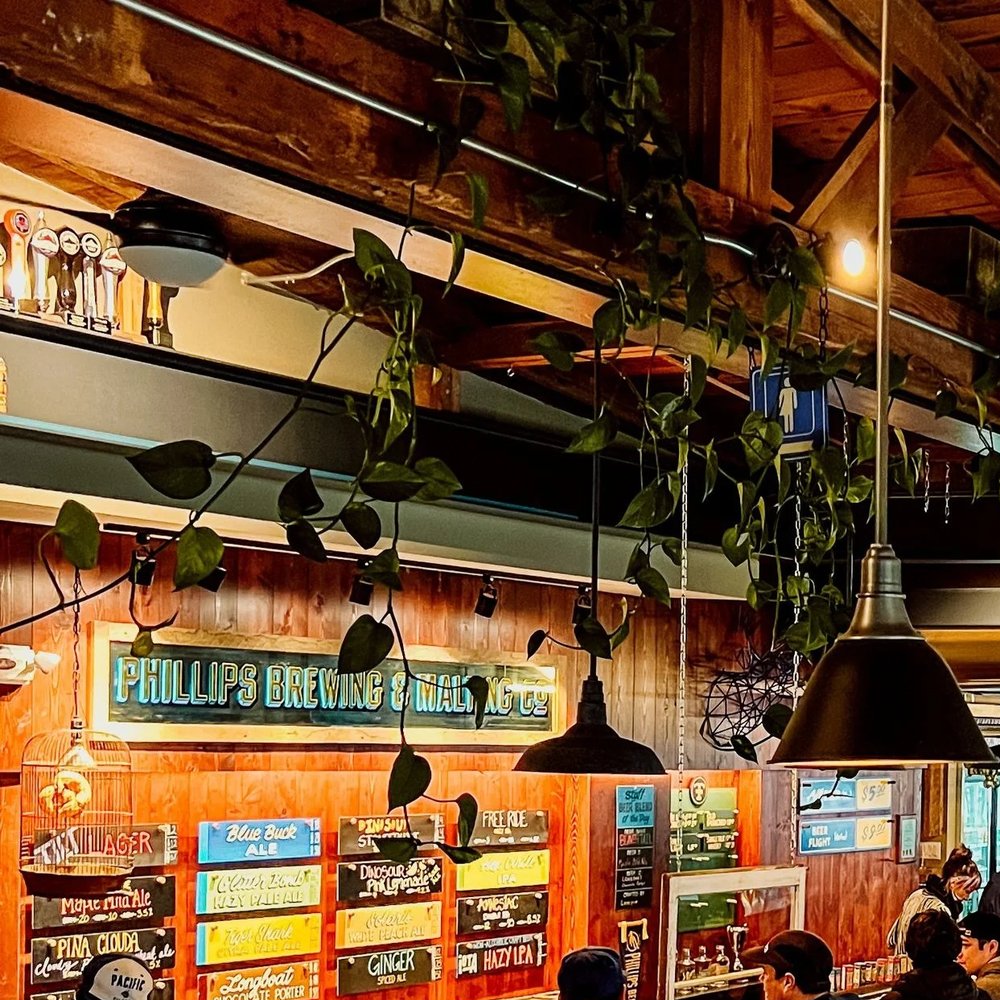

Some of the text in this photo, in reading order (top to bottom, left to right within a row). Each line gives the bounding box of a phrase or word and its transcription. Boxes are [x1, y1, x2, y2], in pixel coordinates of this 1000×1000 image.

[115, 656, 258, 707] PHILLIPS
[265, 663, 385, 712] BREWING
[390, 671, 411, 712] &
[415, 672, 513, 716] MALTNG
[482, 810, 507, 828] FREE
[225, 824, 261, 842] Blue
[262, 822, 298, 841] Buck
[811, 825, 829, 836] BEER
[244, 842, 279, 857] ALE
[808, 837, 832, 849] FLIGHT
[131, 888, 152, 908] Ale
[283, 890, 304, 904] ALE
[367, 949, 415, 977] GINGER
[483, 945, 512, 971] HAZY
[396, 972, 407, 983] ALE
[624, 952, 641, 989] PHILLIPS
[111, 974, 146, 991] PACIFIC
[220, 966, 295, 999] Longboat
[274, 985, 305, 1000] PORTER
